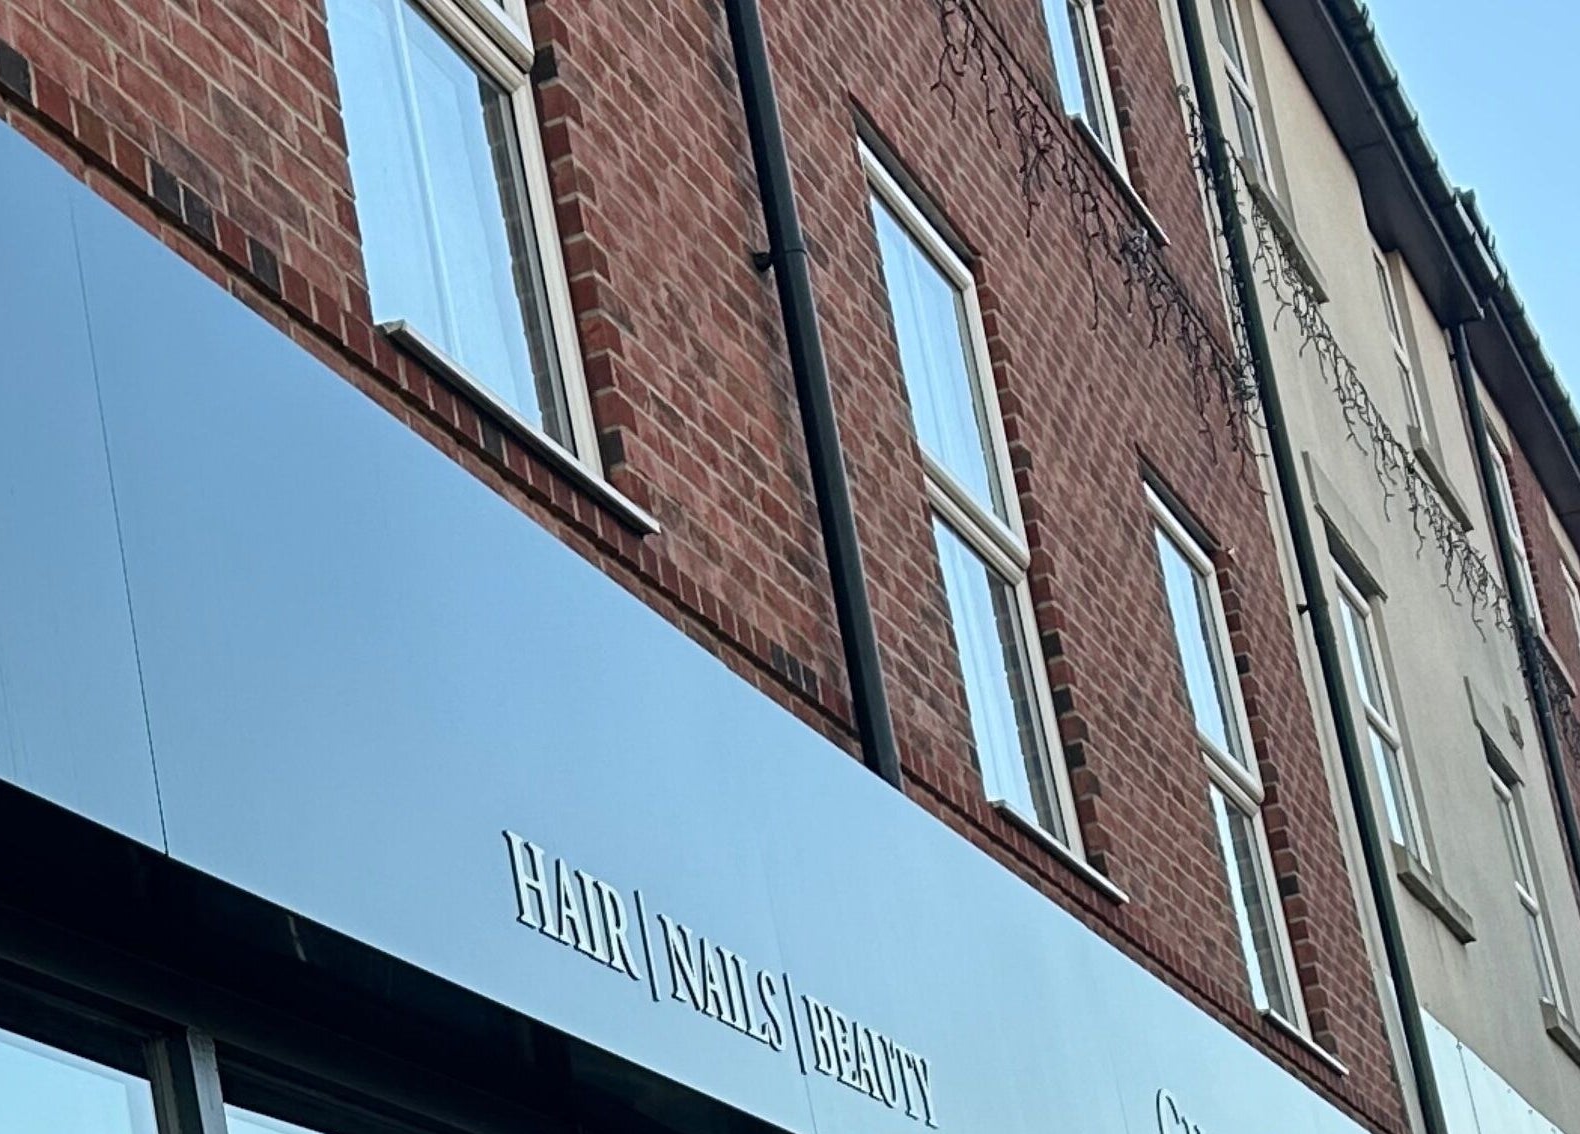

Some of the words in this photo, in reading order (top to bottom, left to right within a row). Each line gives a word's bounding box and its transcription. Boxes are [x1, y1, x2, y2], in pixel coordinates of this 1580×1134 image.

[502, 829, 641, 981] HAIR
[657, 913, 786, 1053] NAILS
[801, 994, 940, 1129] BEAUTY
